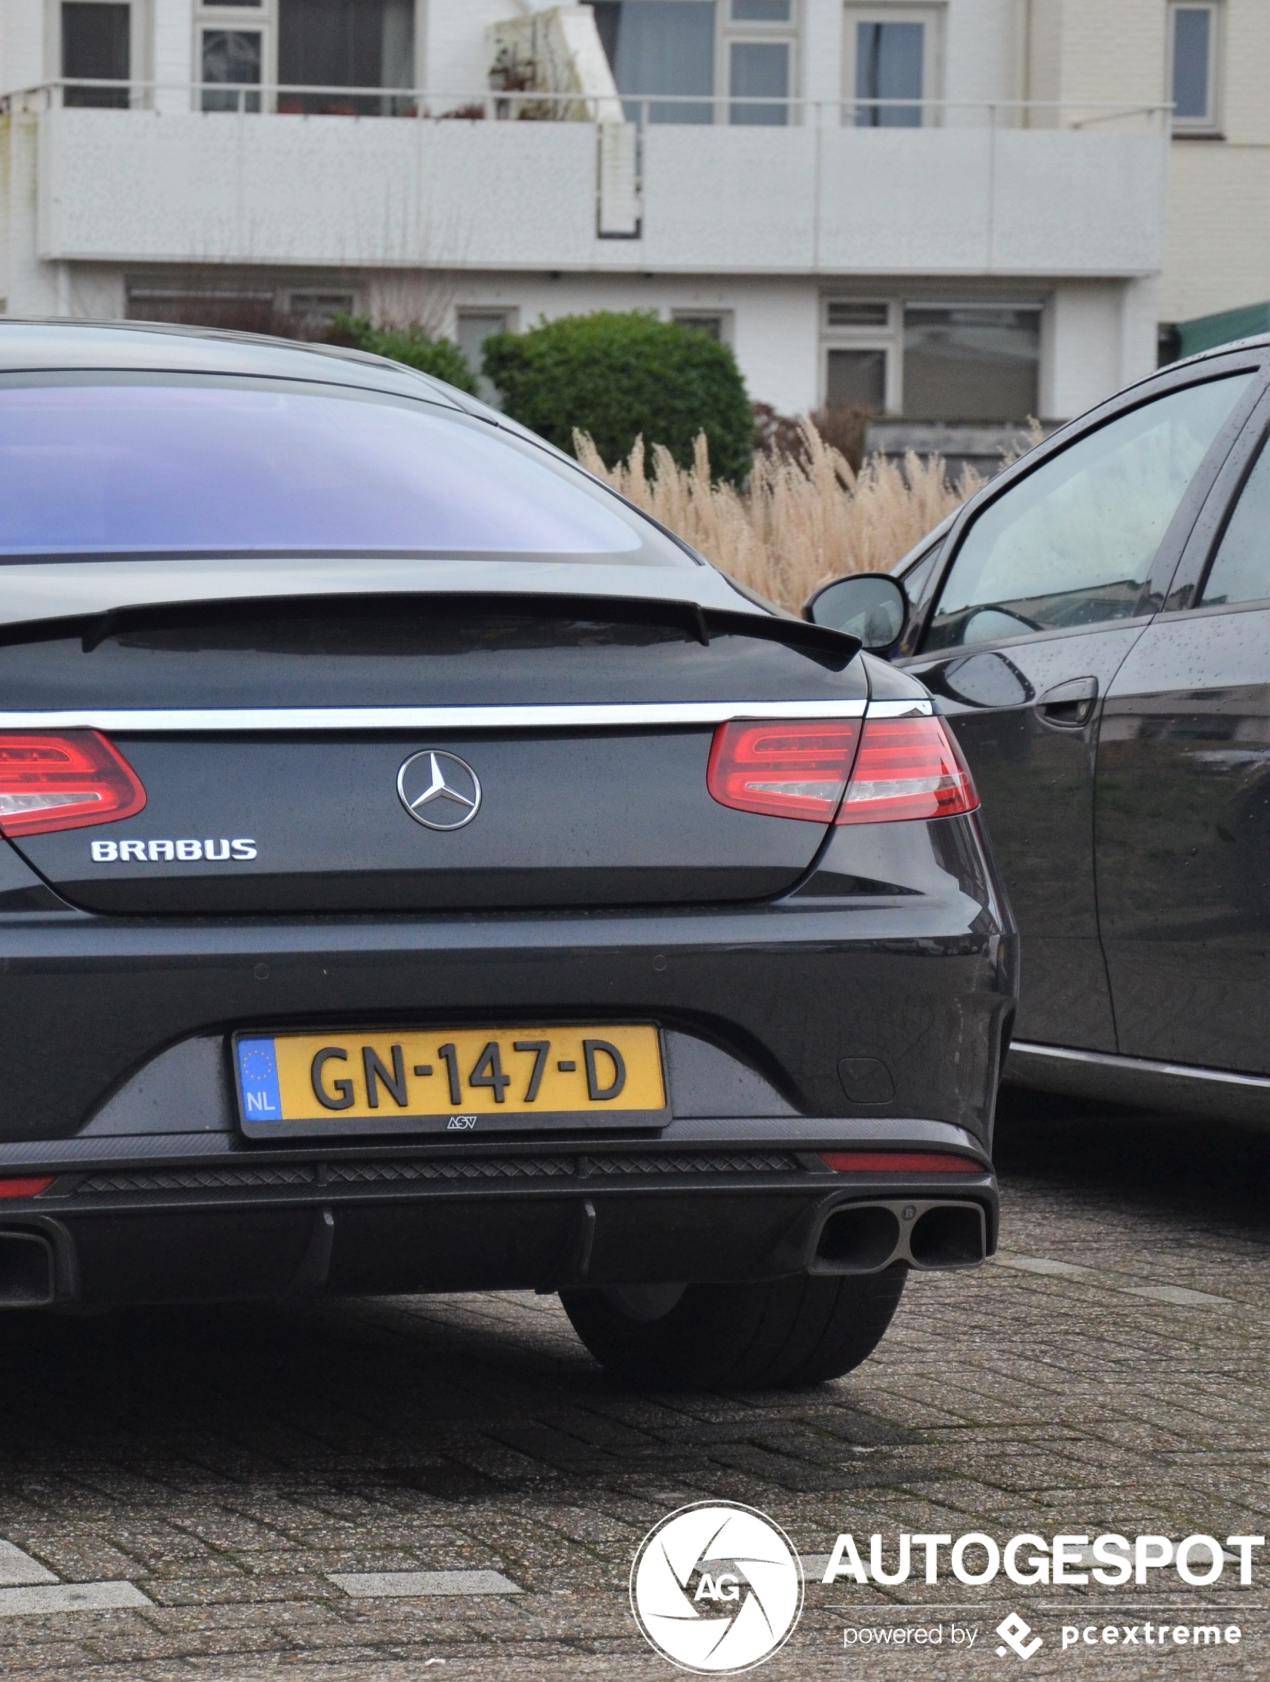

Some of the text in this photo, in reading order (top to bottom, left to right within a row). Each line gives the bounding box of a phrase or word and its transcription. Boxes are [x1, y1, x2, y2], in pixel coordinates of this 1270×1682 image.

[91, 838, 258, 862] BRABUS
[311, 1039, 626, 1110] GN-147-D
[247, 1091, 276, 1112] NL
